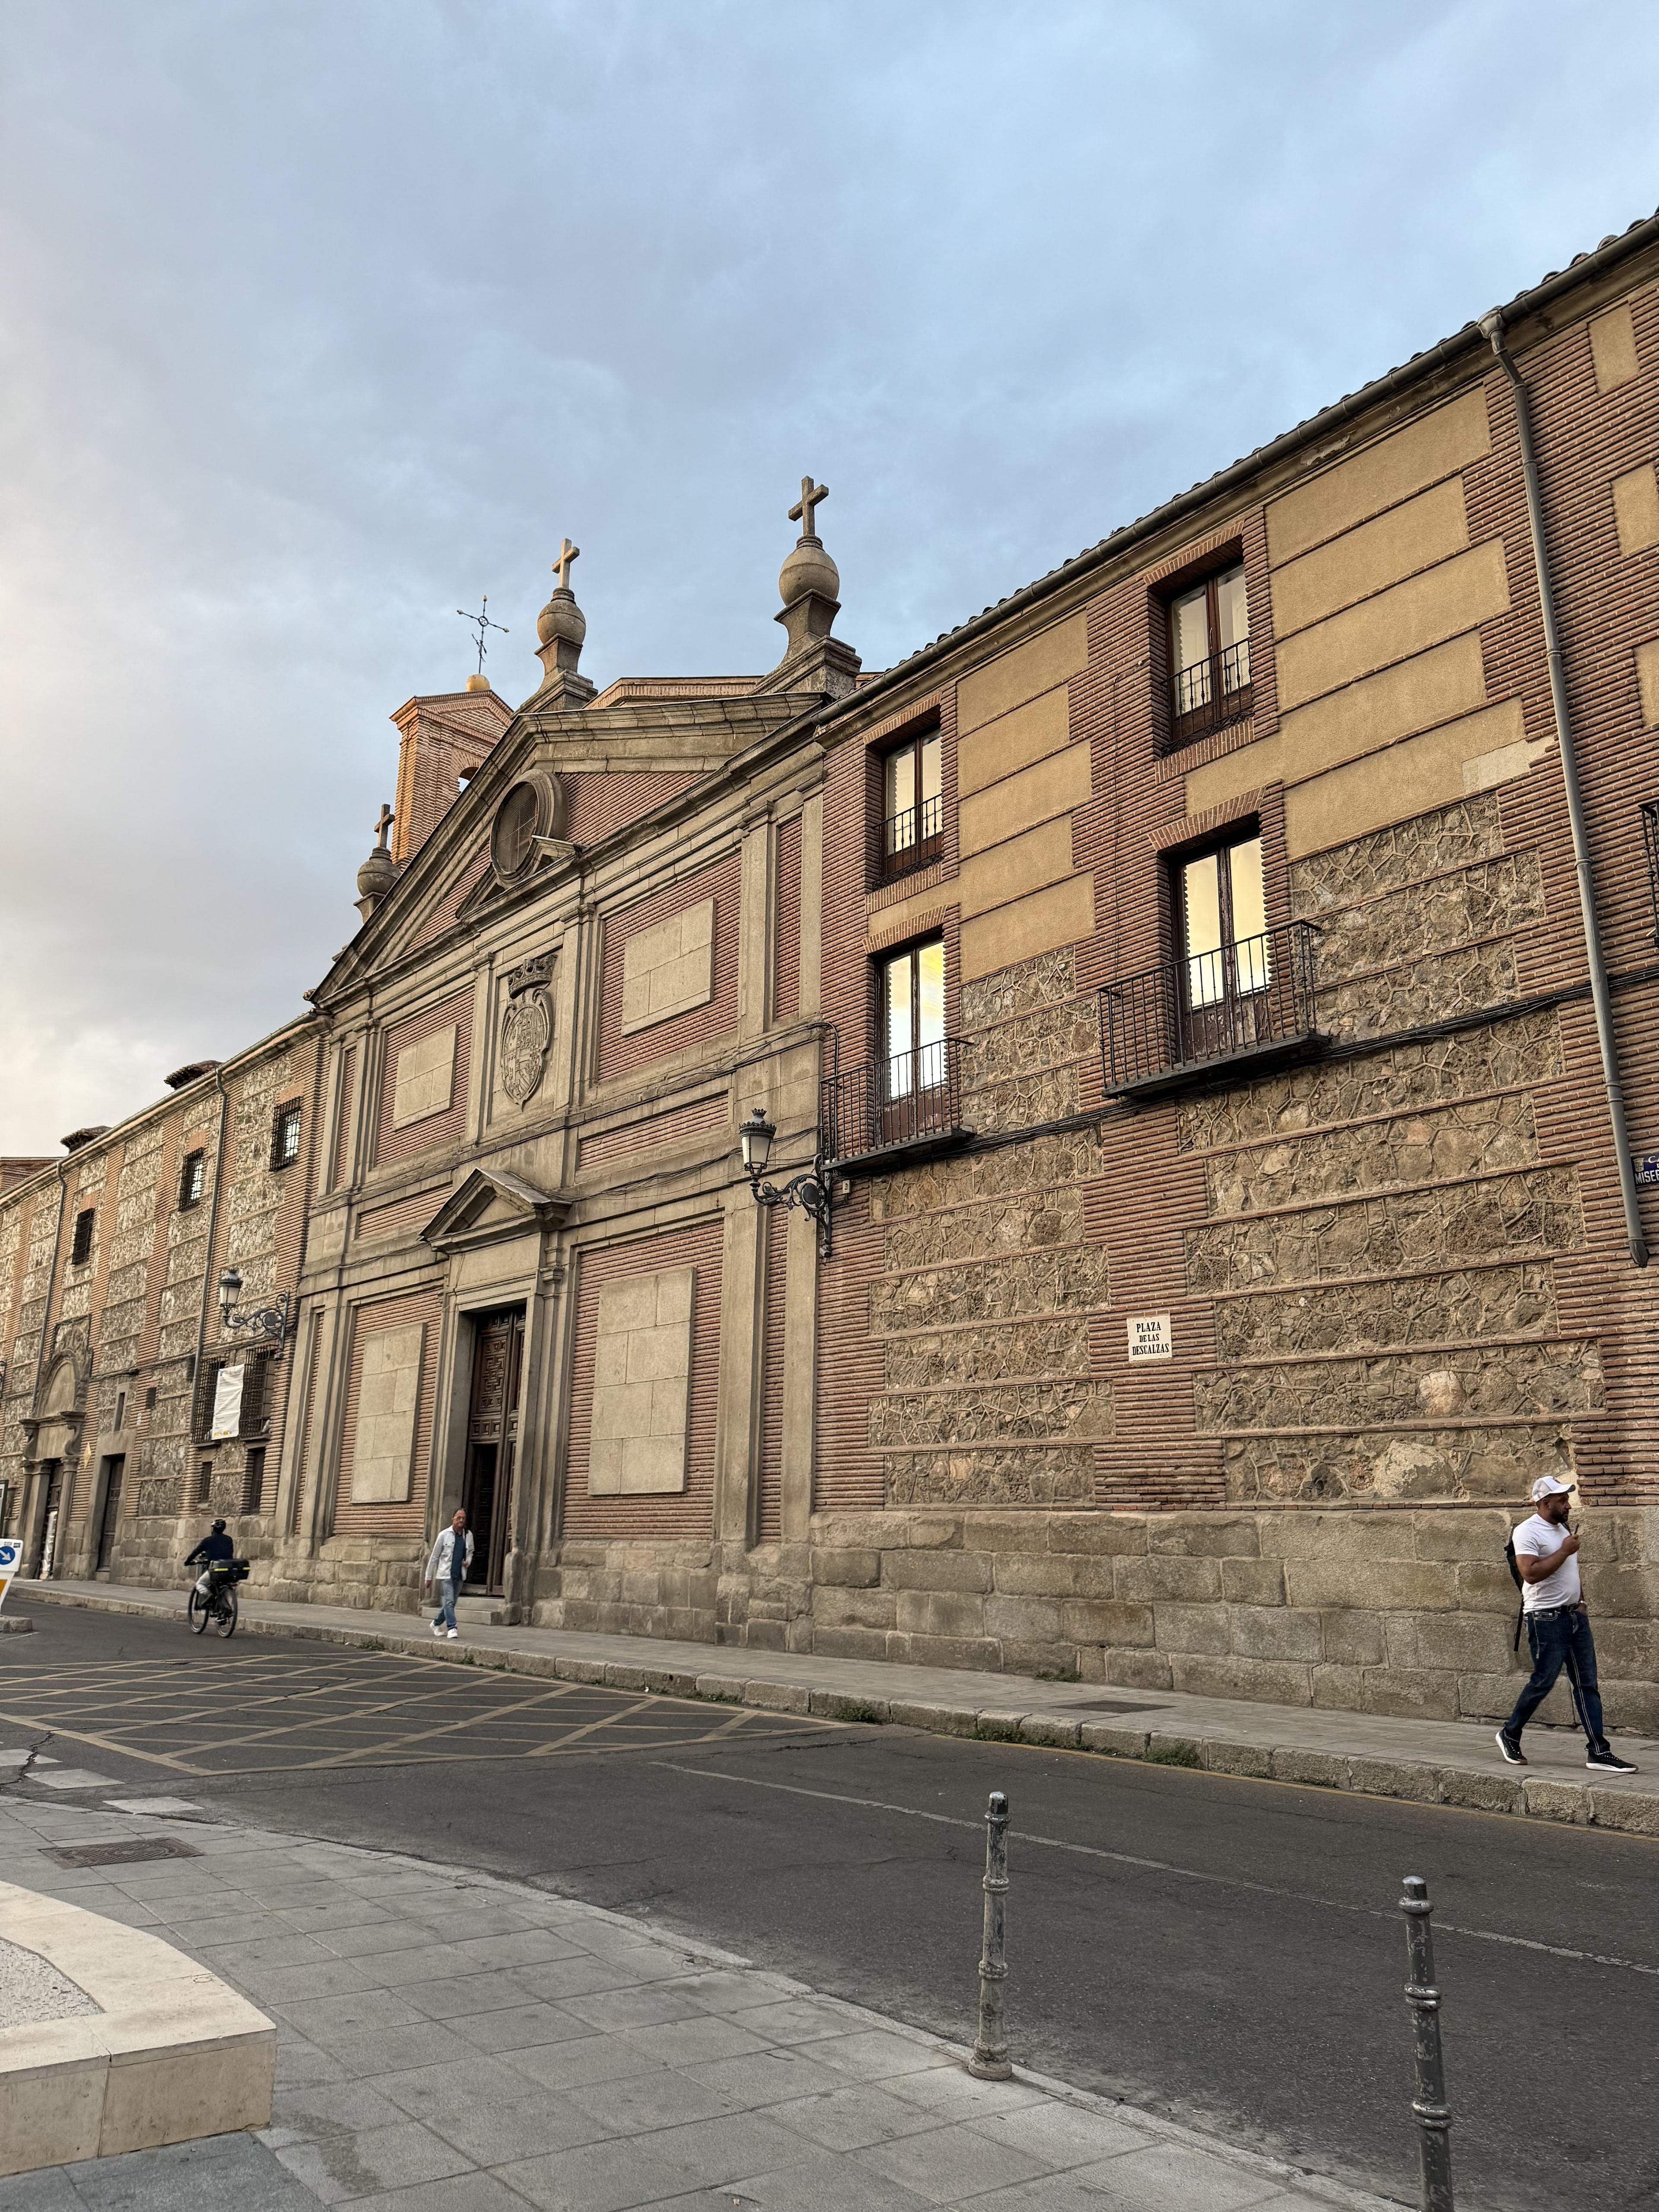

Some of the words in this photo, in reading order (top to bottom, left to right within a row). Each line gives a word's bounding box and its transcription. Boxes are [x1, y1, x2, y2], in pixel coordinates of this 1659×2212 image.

[1136, 1321, 1161, 1332] PLAZA
[1147, 1333, 1160, 1341] LAS
[1132, 1343, 1169, 1355] DESCALZAS
